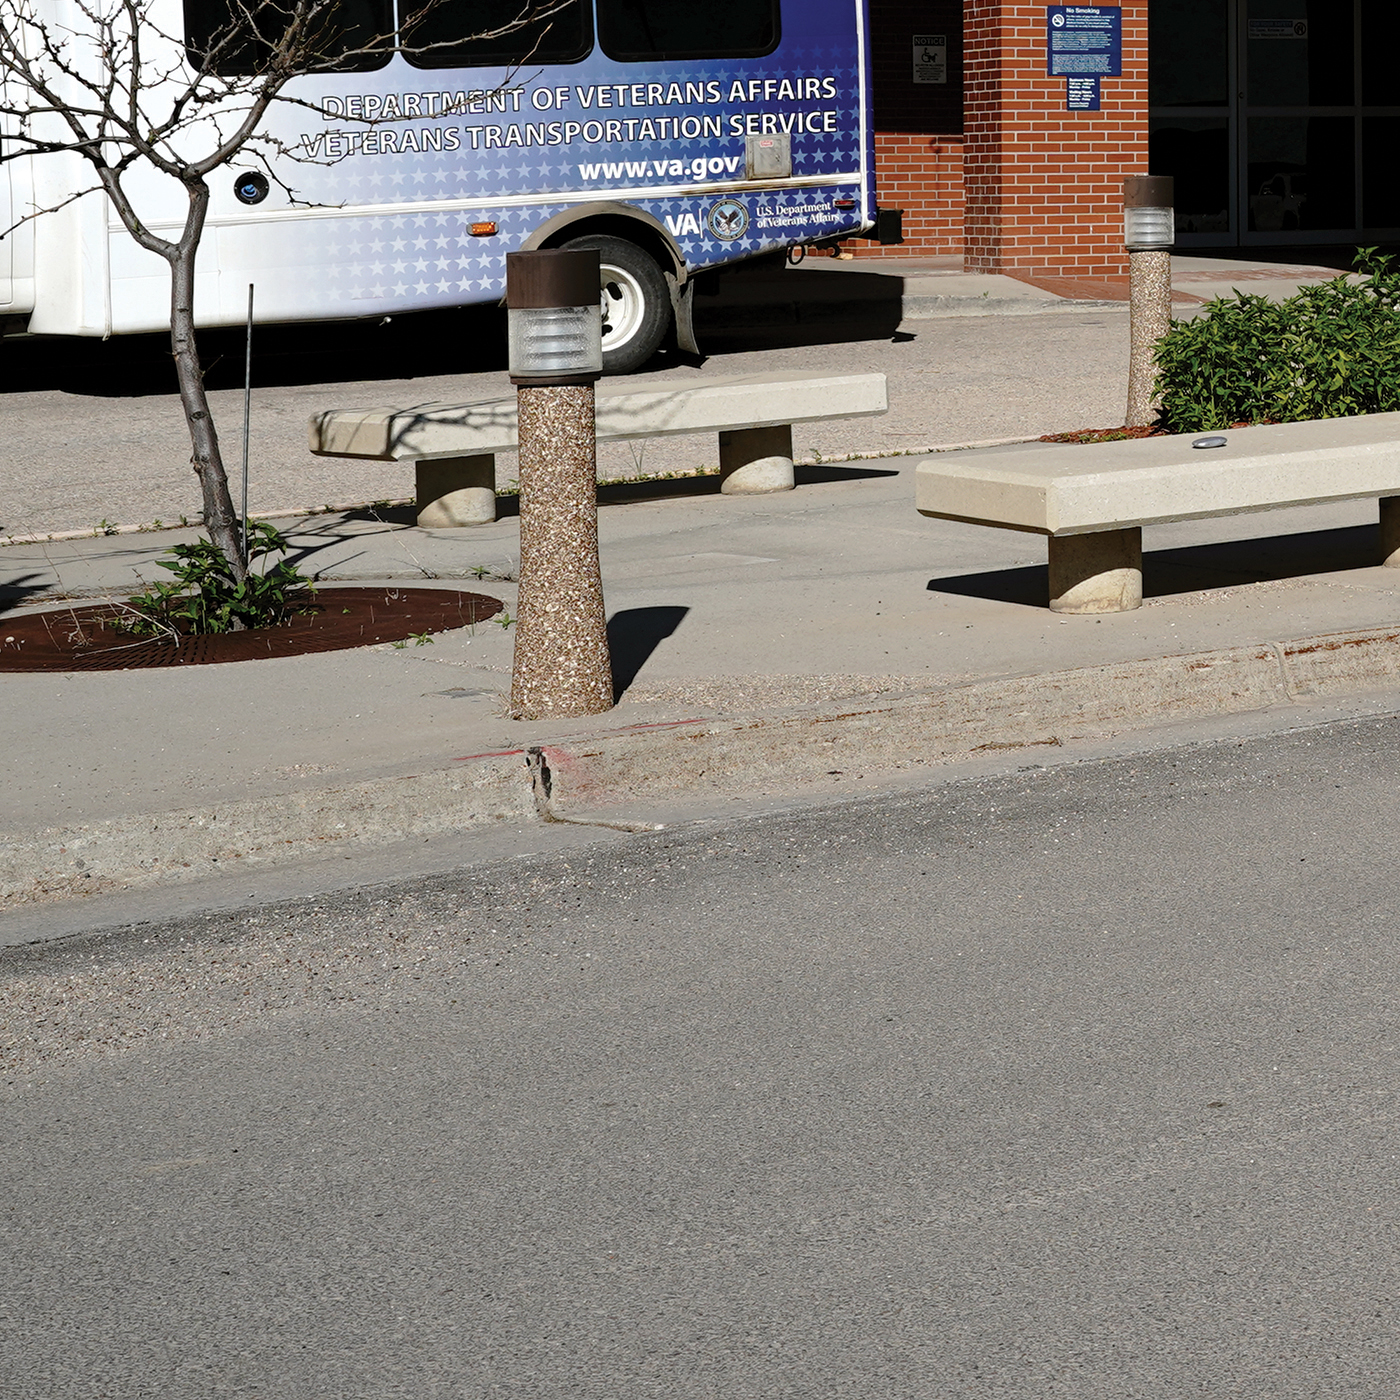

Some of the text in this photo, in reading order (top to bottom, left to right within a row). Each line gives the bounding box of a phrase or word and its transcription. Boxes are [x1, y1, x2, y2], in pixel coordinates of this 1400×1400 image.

[914, 37, 945, 46] NOTICE
[322, 77, 837, 120] DEPARTMENT OF VETERANS AFFAIRS
[301, 110, 838, 158] VETERANS TRANSPORTATION SERVICE
[578, 157, 739, 180] www.va.gov
[756, 202, 832, 217] U.S. Department
[756, 213, 840, 229] of Veterans Affairs
[665, 213, 700, 237] VA
